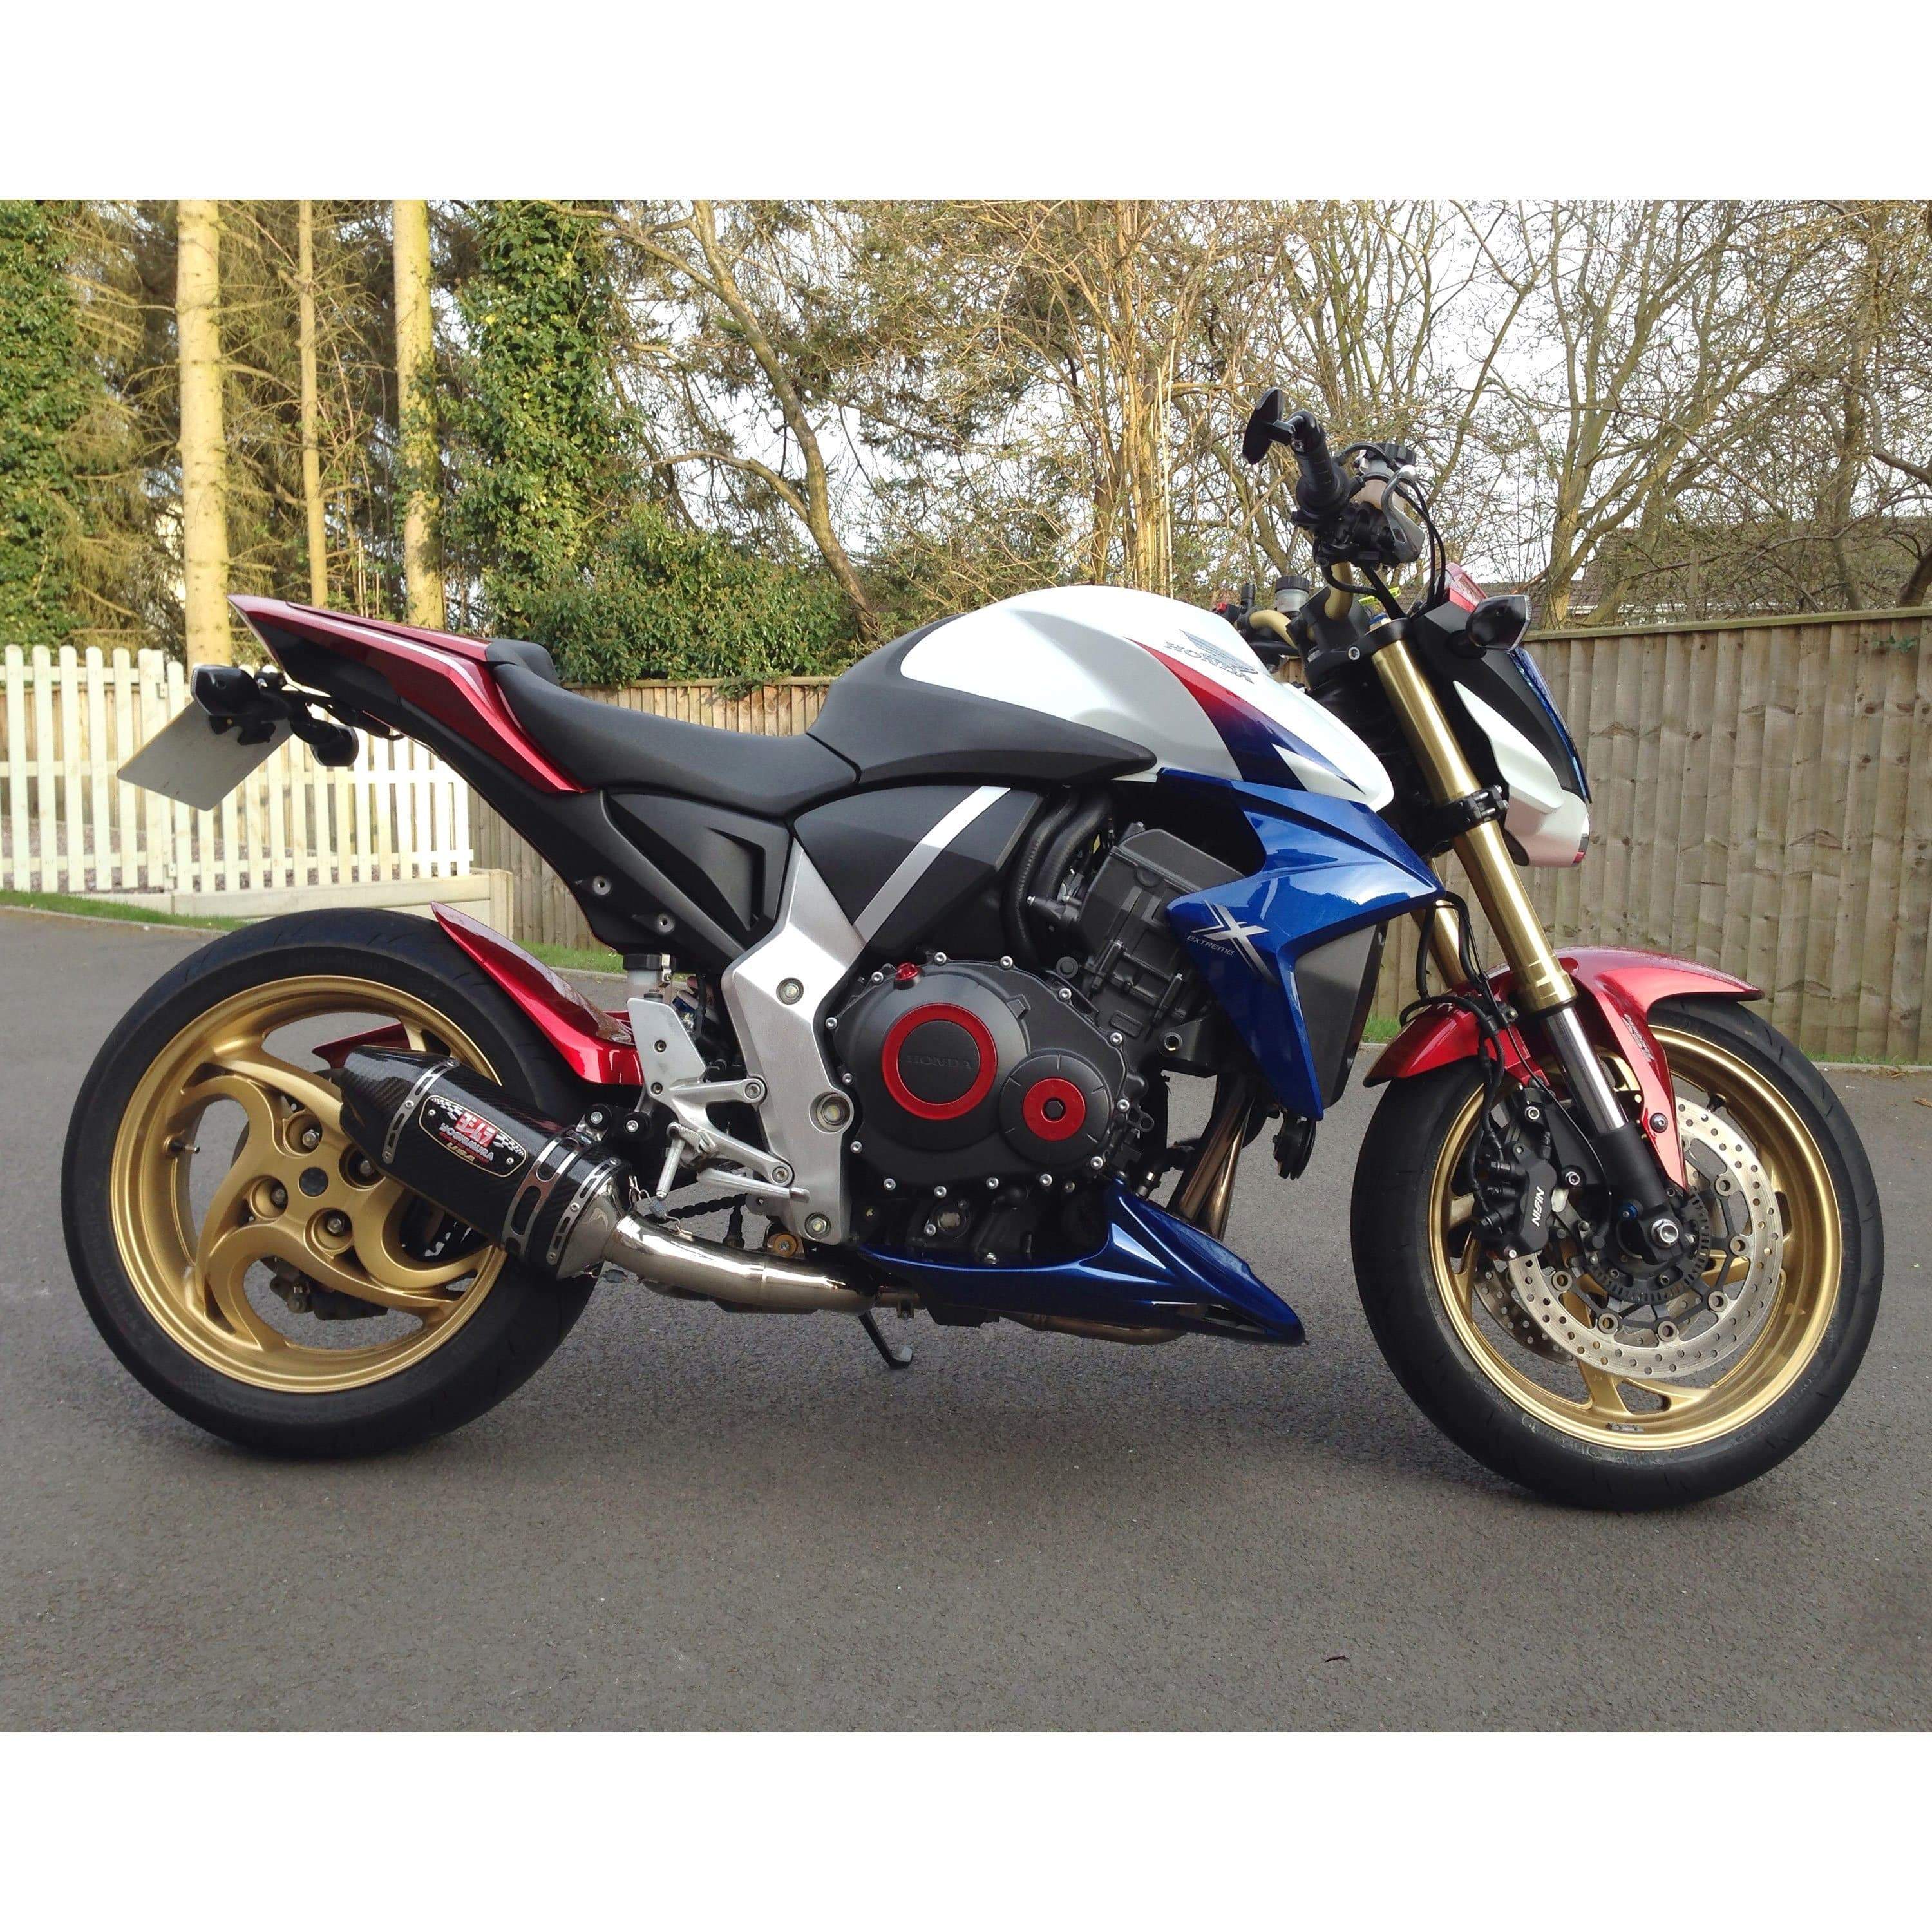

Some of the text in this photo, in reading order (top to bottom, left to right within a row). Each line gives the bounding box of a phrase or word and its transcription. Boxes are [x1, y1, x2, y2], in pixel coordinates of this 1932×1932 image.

[1163, 641, 1255, 684] HONDA
[906, 1054, 974, 1070] HONDA
[439, 1122, 494, 1162] YOSHIMURA
[446, 1142, 475, 1162] USA
